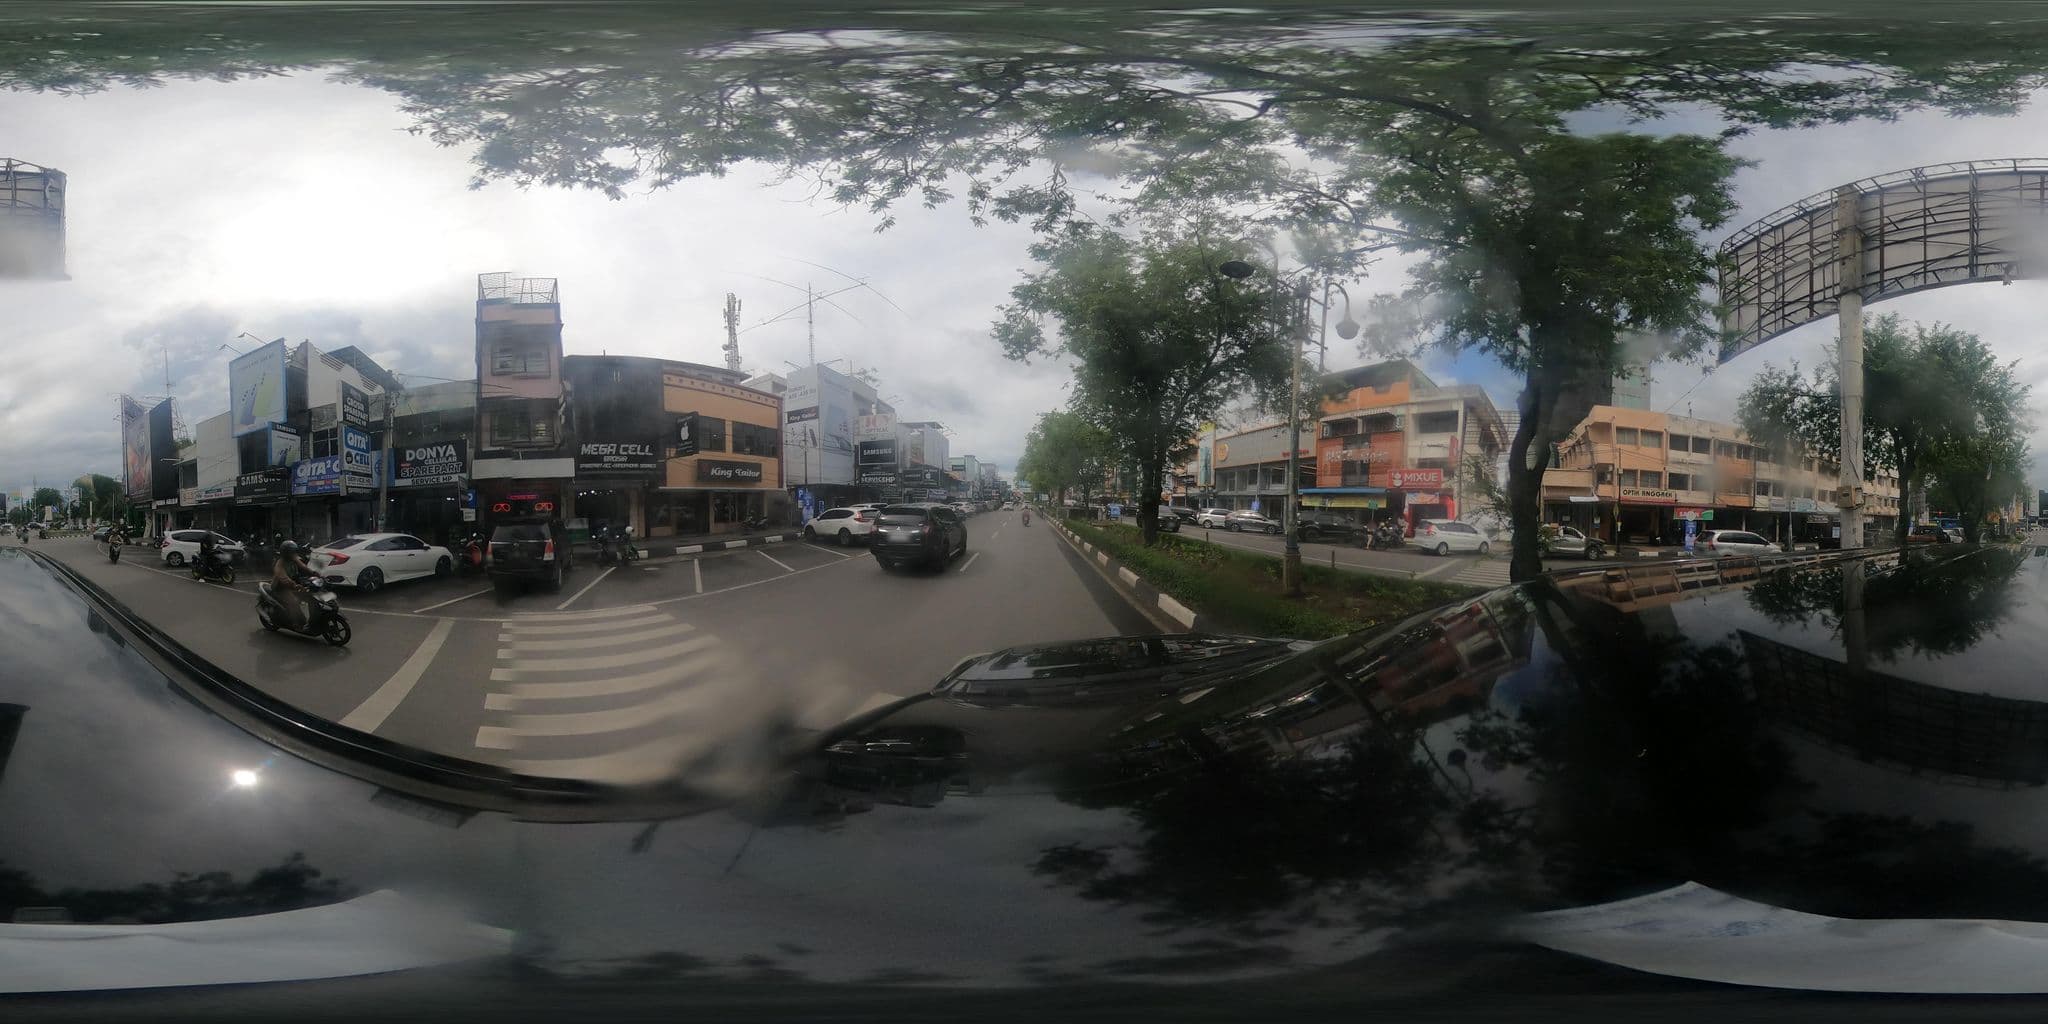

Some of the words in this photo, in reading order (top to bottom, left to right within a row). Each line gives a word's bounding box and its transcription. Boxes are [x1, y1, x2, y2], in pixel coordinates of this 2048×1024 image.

[405, 444, 457, 461] DONYA
[580, 444, 617, 456] MEGA
[619, 444, 654, 456] CELL
[863, 447, 892, 456] SAMSUNG
[424, 456, 458, 465] CELLULAR
[400, 461, 463, 478] SPAREPART
[711, 467, 733, 479] King
[735, 468, 760, 478] Tailor
[1404, 472, 1439, 482] MIXUE
